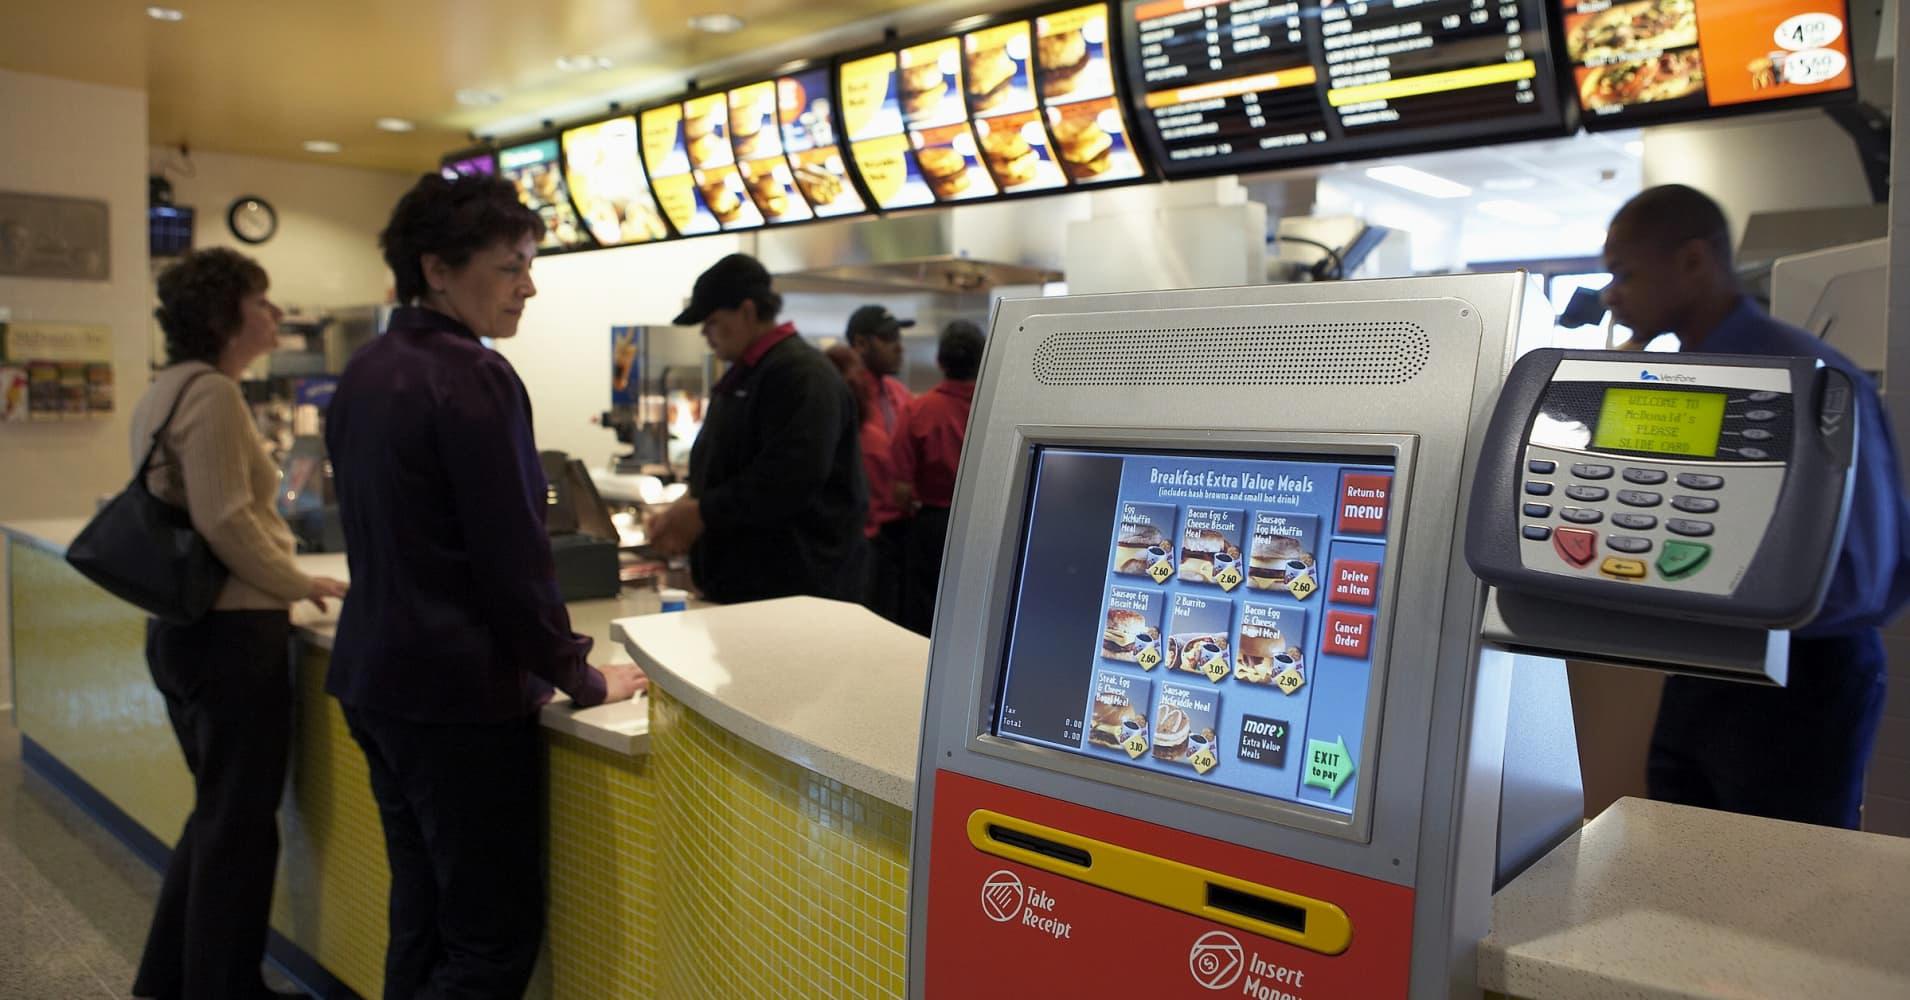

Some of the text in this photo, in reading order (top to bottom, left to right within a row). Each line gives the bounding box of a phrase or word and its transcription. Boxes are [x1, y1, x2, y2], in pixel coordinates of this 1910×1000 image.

[1660, 373, 1697, 383] VeriFone
[1628, 395, 1700, 409] WELCOME TO
[1625, 409, 1697, 425] McDonald's
[1636, 424, 1680, 437] PLEASE
[1618, 437, 1691, 452] SLIDE CARD
[1150, 468, 1313, 492] Breakfast Extra Value Meals
[1158, 486, 1299, 507] (includes hash browns and small hot drink)
[1347, 485, 1385, 499] Return to
[1124, 503, 1135, 514] Egg
[1188, 509, 1228, 521] Bacon Egg &
[1344, 504, 1384, 519] menu
[1122, 513, 1151, 524] McMuffin
[1257, 513, 1286, 525] Sausage
[1121, 523, 1136, 533] Meal
[1187, 519, 1235, 532] Cheese Biscuit
[1256, 524, 1303, 537] Egg McMuffin
[1185, 528, 1201, 538] Meal
[1254, 534, 1272, 544] Meal
[1153, 566, 1169, 576] 2.60
[1341, 569, 1369, 583] Delete
[1220, 574, 1237, 584] 2.60
[1293, 581, 1311, 592] 2.60
[1336, 582, 1370, 596] an Item
[1111, 588, 1149, 602] Sausage Egg
[1110, 598, 1149, 611] Biscuit Meal
[1175, 596, 1206, 609] 2 Burrito
[1174, 606, 1190, 617] Meal
[1245, 604, 1280, 620] Bacon Egg
[1243, 615, 1277, 628] & Cheese
[1334, 620, 1363, 635] Cancel
[1263, 628, 1280, 639] Meal
[1334, 633, 1360, 648] Order
[1140, 653, 1156, 664] 2.60
[1209, 663, 1224, 675] 3.05
[1119, 676, 1131, 689] Egg
[1280, 675, 1298, 687] 2.90
[1104, 684, 1126, 695] Cheese
[1163, 684, 1190, 698] Sausage
[1113, 695, 1129, 707] Meal
[1193, 700, 1211, 713] Meal
[1005, 705, 1082, 729] Tax 0.00
[1003, 717, 1081, 741] Total 0.00
[1244, 719, 1277, 737] more
[1129, 741, 1143, 752] 3.10
[1242, 735, 1281, 752] Extra Value
[1241, 746, 1261, 760] Meals
[1314, 750, 1340, 767] EXIT
[1194, 755, 1211, 767] 2.40
[1312, 766, 1338, 782] to pay
[1027, 886, 1056, 911] Take
[1022, 907, 1072, 939] Receipt
[1249, 952, 1304, 988] Insert
